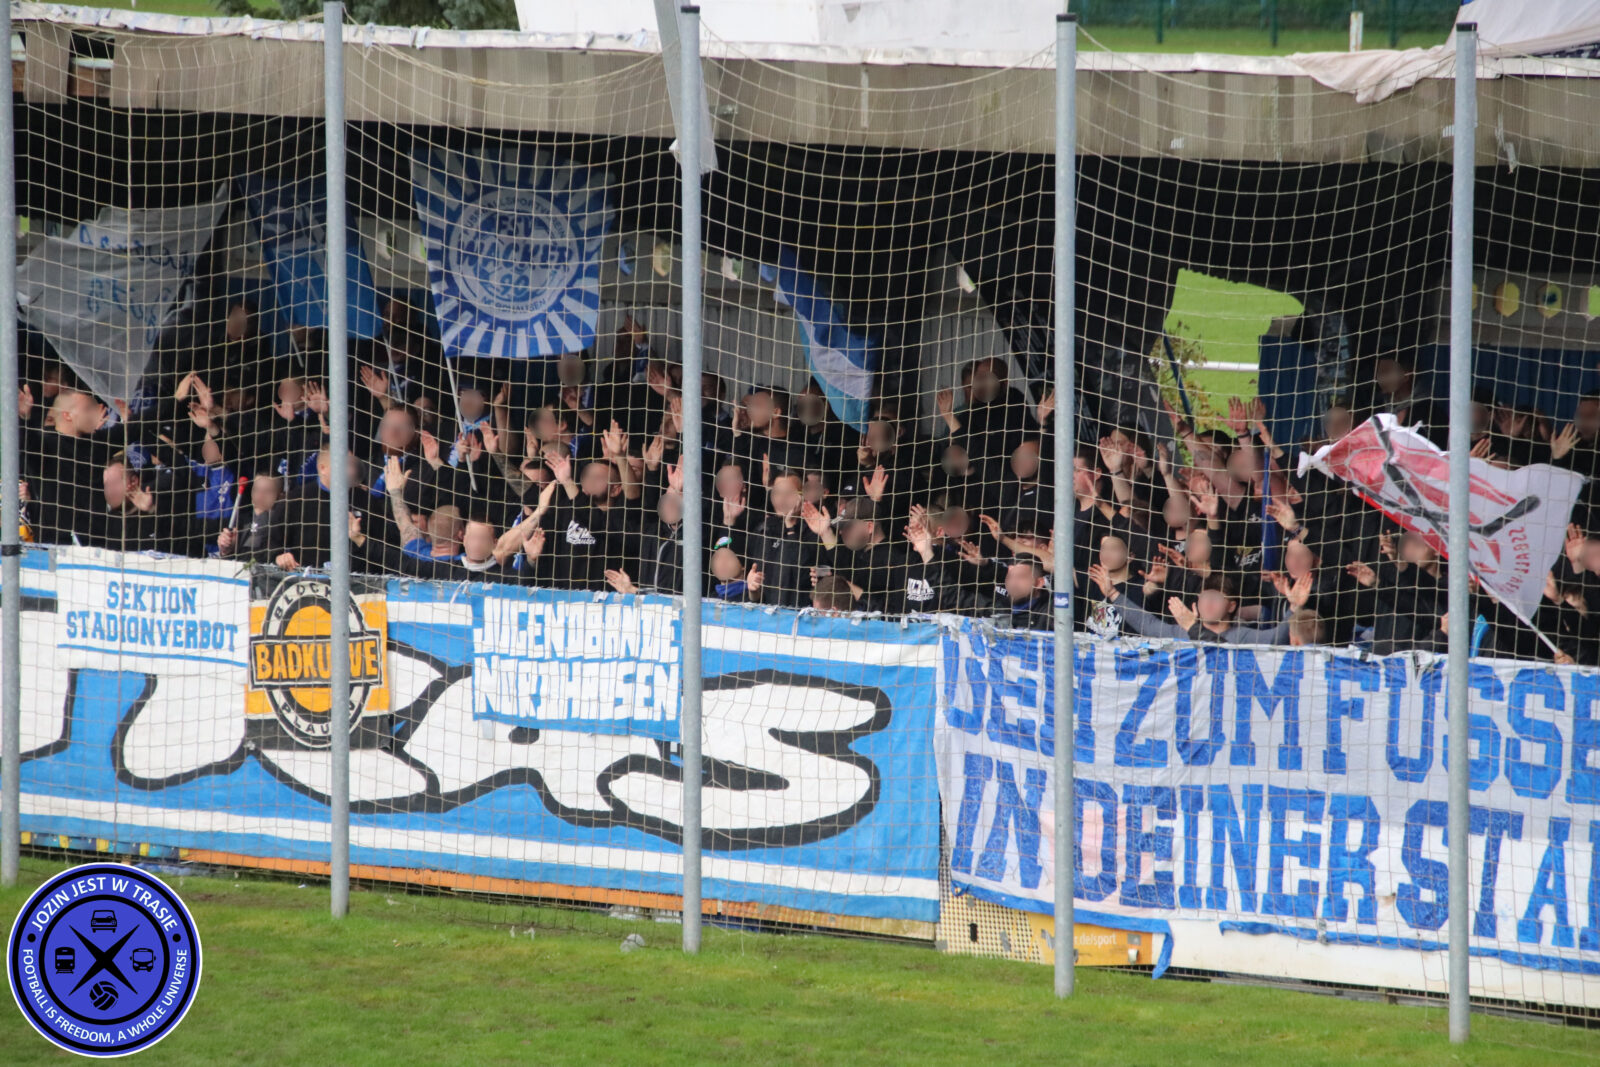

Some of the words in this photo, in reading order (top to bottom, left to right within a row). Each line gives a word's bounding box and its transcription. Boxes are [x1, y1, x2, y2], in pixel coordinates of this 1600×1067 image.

[456, 240, 573, 273] WACKER
[106, 580, 197, 615] SEKTION
[66, 610, 238, 653] STADIONVERBOT
[473, 596, 680, 663] JUGENDBANDE
[255, 640, 378, 680] BADKUVE
[474, 655, 680, 721] NORDHAUSEN
[1114, 647, 1305, 771] ZUM
[951, 751, 1047, 889] IN
[1070, 777, 1379, 925] DEINER
